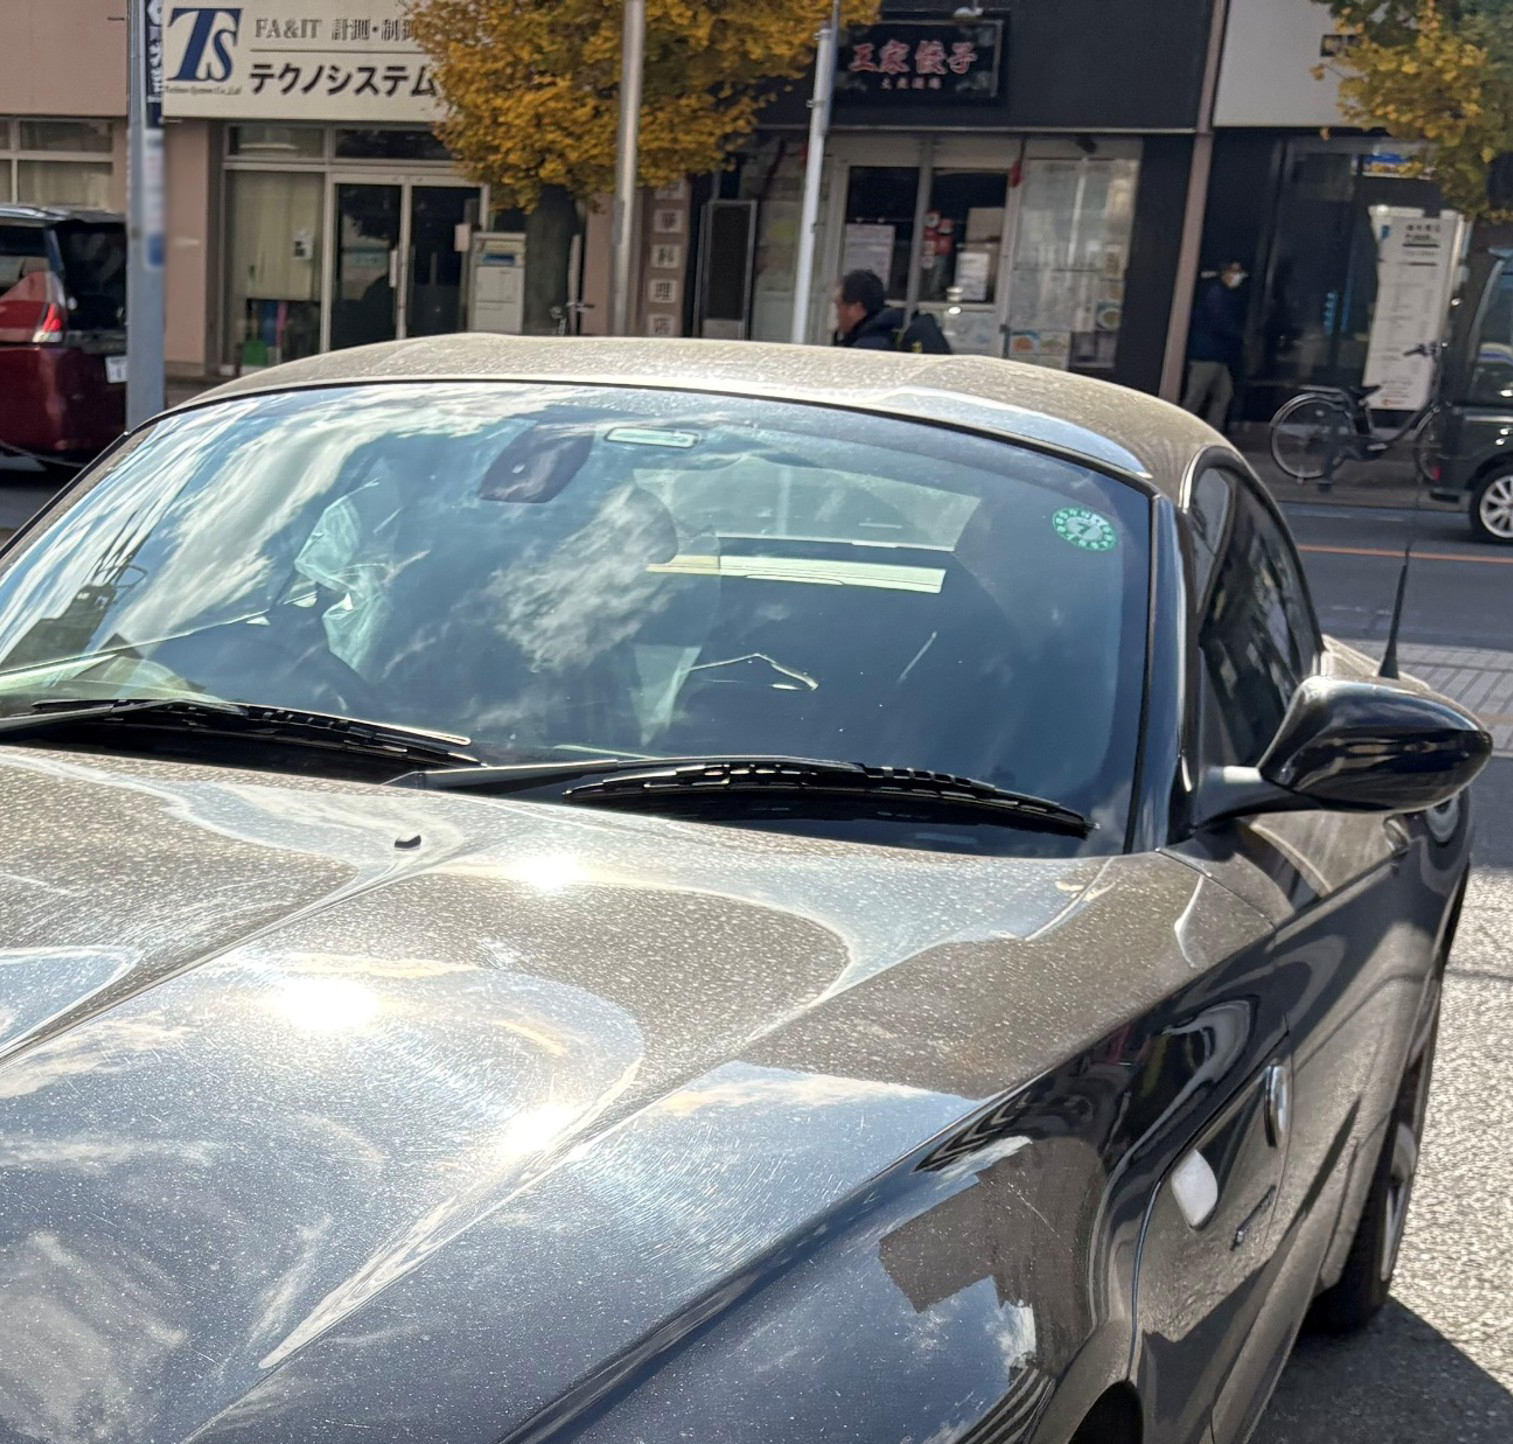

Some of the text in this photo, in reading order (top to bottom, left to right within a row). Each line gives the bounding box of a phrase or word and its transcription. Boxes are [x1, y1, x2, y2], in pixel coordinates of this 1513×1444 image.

[255, 18, 322, 39] FA&IT
[250, 63, 438, 97] テクノシステム
